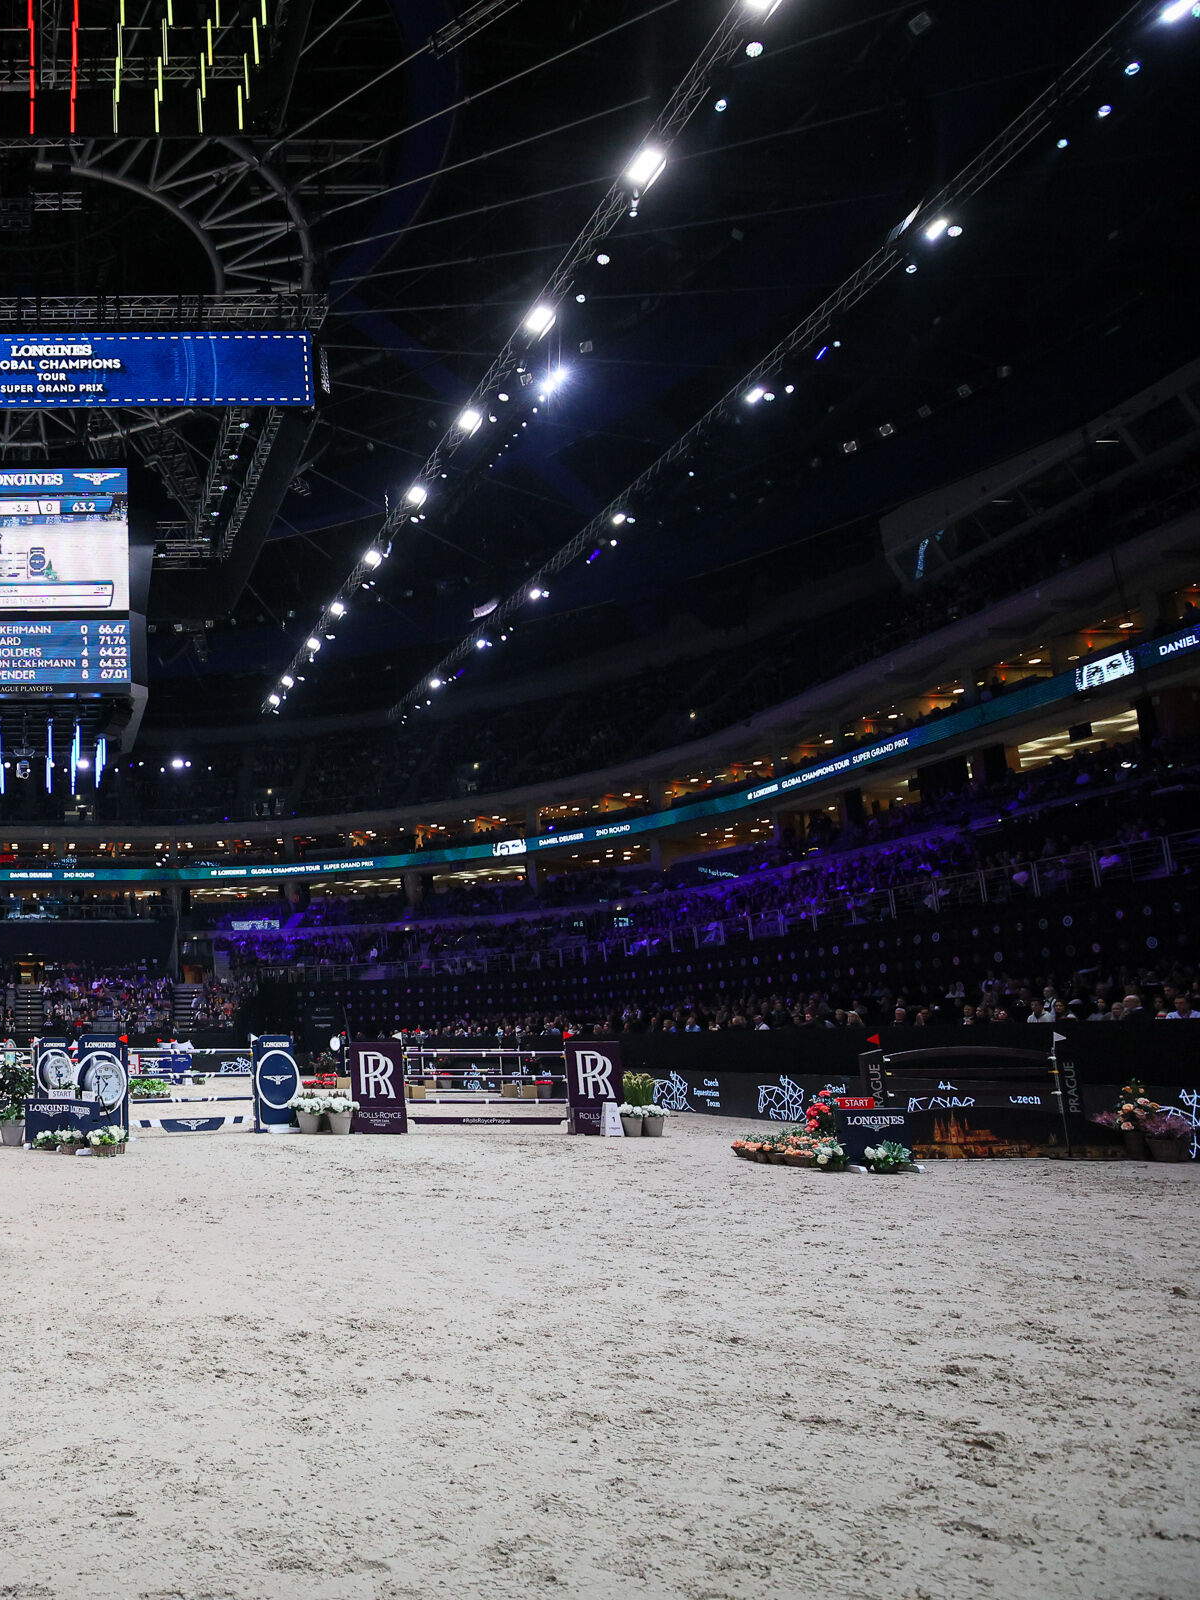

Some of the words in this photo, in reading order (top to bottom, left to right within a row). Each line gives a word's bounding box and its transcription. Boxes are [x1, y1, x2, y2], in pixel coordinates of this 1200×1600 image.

[10, 344, 92, 357] LONGINES
[38, 358, 121, 370] CHAMPIONS
[37, 372, 66, 381] TOUR
[0, 384, 34, 393] SUPER
[37, 384, 76, 392] GRAND
[79, 383, 104, 392] PRIX
[72, 502, 96, 512] 63.2
[80, 625, 88, 634] 0
[99, 625, 125, 634] 66.47
[82, 636, 88, 645] 1
[99, 636, 126, 645] 71.76
[1158, 634, 1200, 656] DANIEL
[81, 648, 88, 656] 4
[99, 647, 127, 656] 64.22
[99, 658, 126, 668] 64.53
[101, 670, 128, 678] 67.01
[781, 776, 802, 789] GLOBAL
[802, 764, 834, 782] CHAMPIONS
[834, 759, 850, 771] TOUR
[852, 752, 871, 764] SUPER
[871, 745, 893, 757] GRAND
[894, 738, 909, 749] PRIX
[538, 838, 558, 846] DANIEL
[559, 833, 584, 842] DEUSSER
[596, 828, 608, 836] 2ND
[609, 824, 630, 834] ROUND
[704, 1078, 719, 1087] Czech
[868, 1064, 885, 1107] RAGUE
[1064, 1061, 1081, 1113] PRAGUE
[693, 1088, 719, 1097] Equestrian
[706, 1099, 720, 1108] Team
[844, 1099, 868, 1107] START
[29, 1104, 69, 1112] LONGINE
[70, 1105, 90, 1114] LONGINES
[847, 1115, 904, 1125] LONGINES
